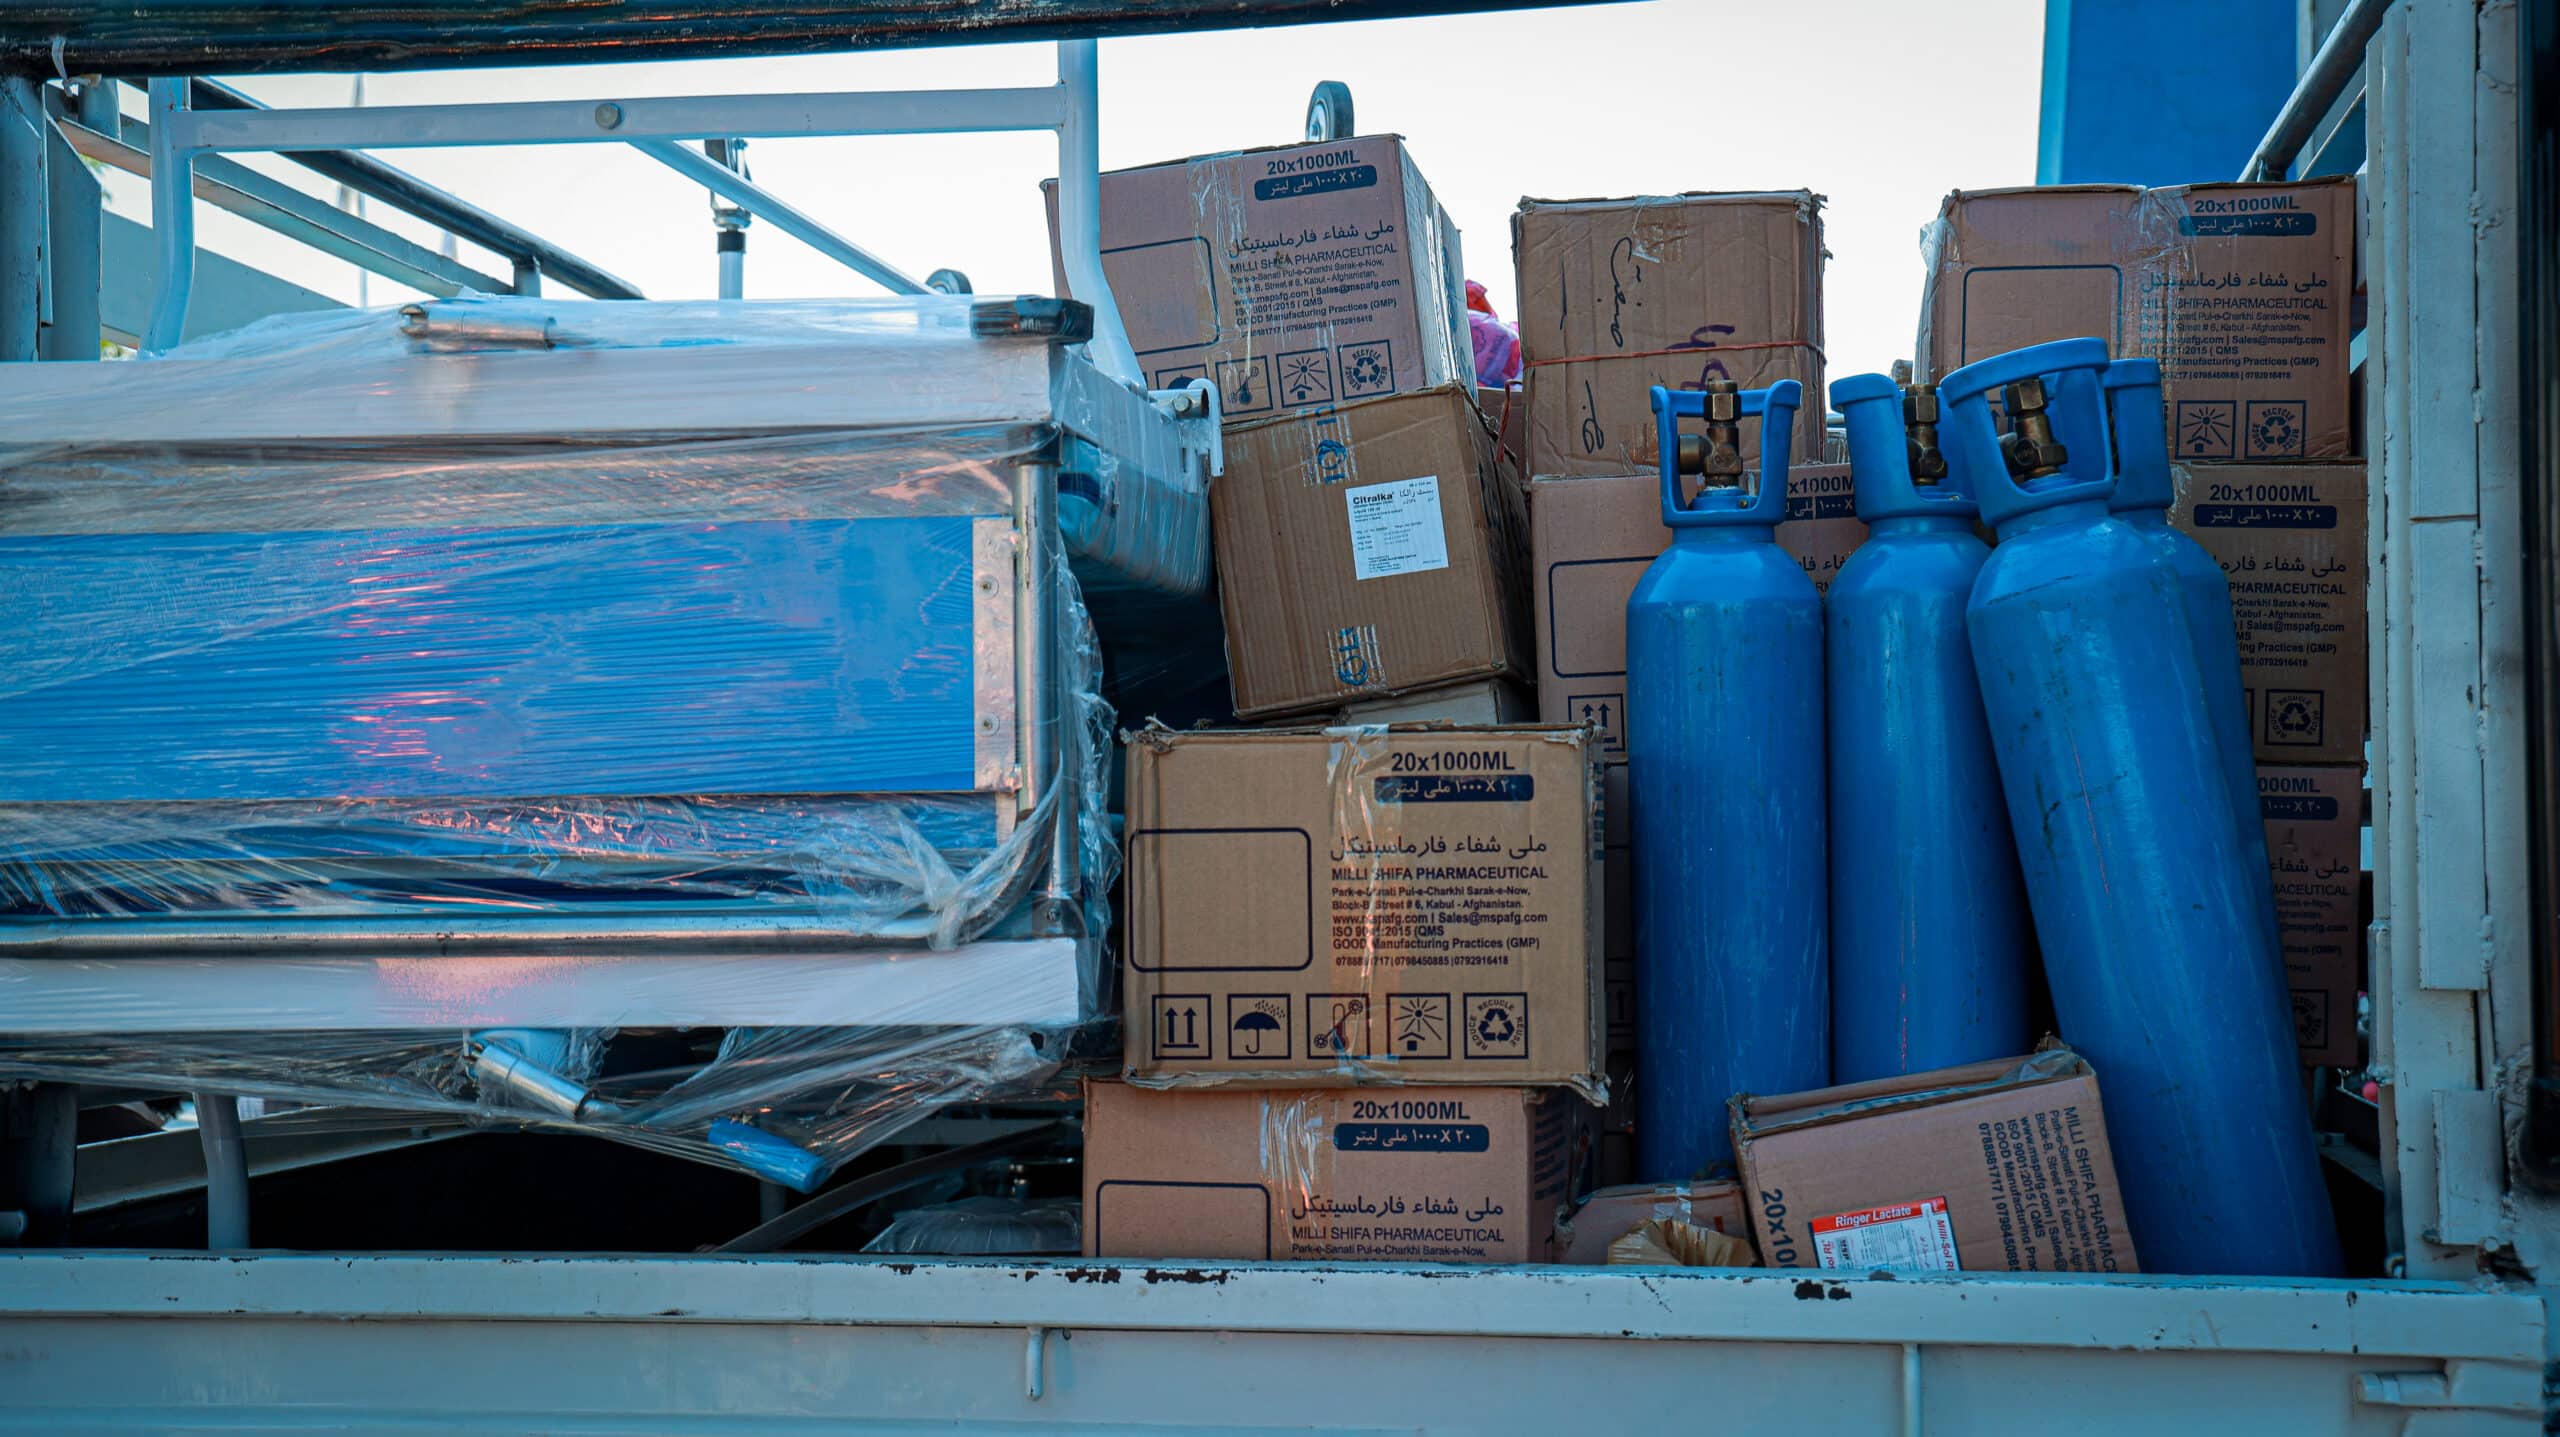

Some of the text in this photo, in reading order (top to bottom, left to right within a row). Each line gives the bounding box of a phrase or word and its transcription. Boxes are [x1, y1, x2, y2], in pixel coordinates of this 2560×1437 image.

[1267, 149, 1360, 175] 20x1000ML
[2193, 195, 2301, 213] 20x1000ML
[1364, 219, 1394, 241] ملی
[1230, 260, 1258, 273] MILLI
[1294, 242, 1398, 265] PHARMACEUTICAL
[2294, 271, 2328, 293] ملی
[2213, 297, 2329, 310] PHARMACEUTICAL
[2231, 335, 2326, 346] Sales@mspafg.com
[2242, 357, 2288, 366] Practices
[2290, 356, 2319, 368] (GMP)
[1787, 475, 1854, 495] x1000M
[2208, 483, 2321, 502] 20x1000ML
[1353, 492, 1393, 505] Citralka
[2262, 555, 2305, 572] شفاء
[2311, 556, 2347, 578] ملی
[2228, 582, 2347, 595] PHARMACEUTICAL
[2235, 631, 2251, 641] MS
[2246, 620, 2345, 634] Sales@mspafg.com
[2257, 641, 2305, 653] Practices
[2306, 641, 2337, 656] (GMP)
[1391, 751, 1516, 772] 20x1000ML
[2257, 776, 2321, 793] 000ML
[1454, 835, 1501, 853] شفاء
[1508, 834, 1547, 860] ملی
[1332, 867, 1368, 880] MILLI
[1416, 866, 1549, 880] PHARMACEUTICAL
[2315, 857, 2351, 880] ملی
[1398, 886, 1464, 897] Pul-e-Charkhi
[1466, 885, 1531, 896] Sarak-e-Now,
[2272, 883, 2352, 897] MACEUTICAL
[1332, 900, 1371, 910] Block-B
[1375, 900, 1404, 910] Street
[1425, 899, 1455, 910] Kabul
[1462, 899, 1524, 911] Afghanistan.
[1438, 911, 1548, 926] Sales@mspafg.com
[1332, 926, 1352, 937] ISO
[1355, 926, 1411, 937] 901:2015
[1333, 938, 1366, 949] GOOD
[1452, 938, 1503, 949] Practices
[1506, 937, 1540, 951] (GMP)
[1353, 1101, 1471, 1120] 20x1000ML
[2063, 1106, 2086, 1145] MILLI
[1994, 1121, 2012, 1158] GOOD
[2006, 1119, 2021, 1140] ISO
[2030, 1209, 2046, 1238] QMS
[2074, 1147, 2096, 1193] SHIFA
[1412, 1195, 1458, 1215] شفاء
[1465, 1196, 1504, 1222] ملی
[1834, 1205, 1911, 1228] Ringer Lactate
[1292, 1226, 1504, 1242] MILLI SHIFA PHARMACEUTICAL
[1760, 1188, 1797, 1268] 20x10
[1936, 1218, 1952, 1259] Milli-Sol
